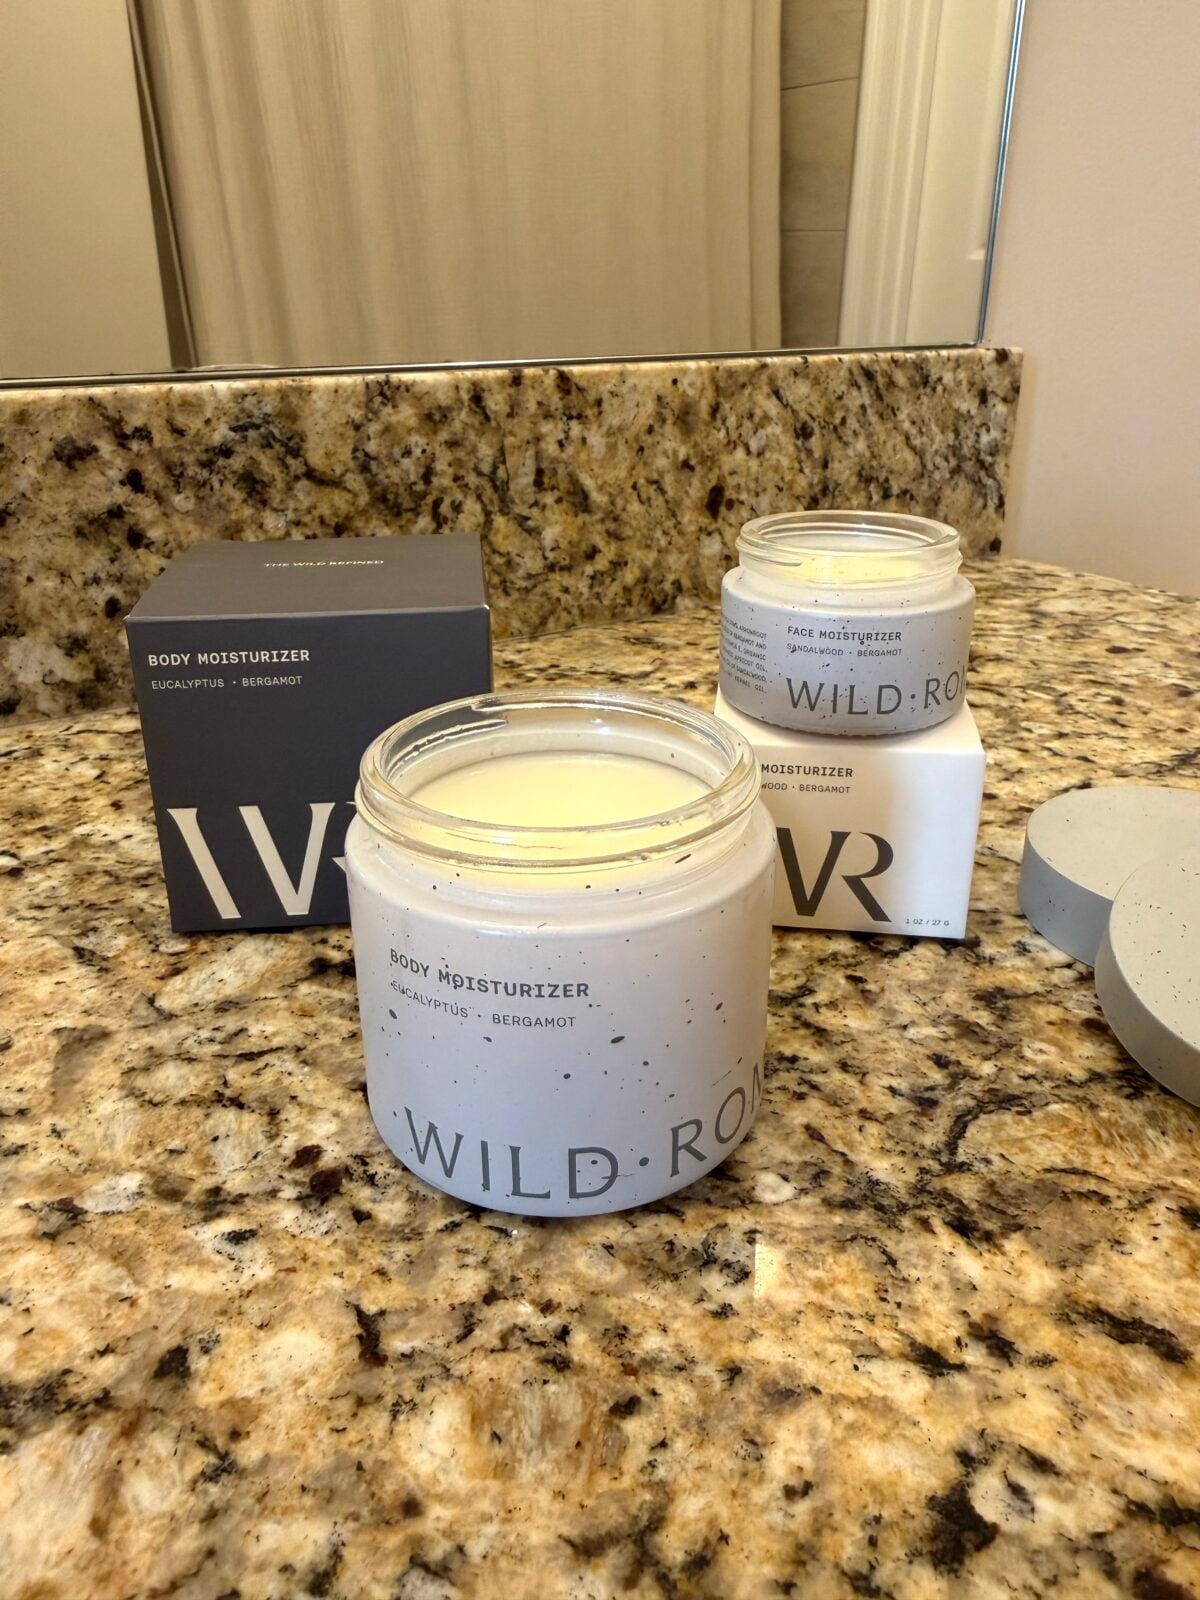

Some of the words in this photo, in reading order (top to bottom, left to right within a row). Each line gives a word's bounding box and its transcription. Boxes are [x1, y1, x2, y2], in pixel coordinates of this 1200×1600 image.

[787, 626, 815, 638] FACE
[819, 630, 902, 642] MOISTURIZER
[787, 642, 844, 656] SANDALWOOD
[857, 648, 903, 657] BERGAMOT
[148, 652, 191, 667] BODY
[197, 649, 310, 665] MOISTURIZER
[151, 678, 225, 690] EUCALYPTUS
[242, 675, 303, 687] BERGAMOT
[761, 763, 854, 778] MOISTURIZER
[799, 784, 851, 794] BERGAMOT
[390, 948, 430, 978] BODY
[438, 968, 590, 998] MOISTURIZER
[391, 980, 469, 1018] EUCALYPTUS
[492, 1013, 577, 1028] BERGAMOT
